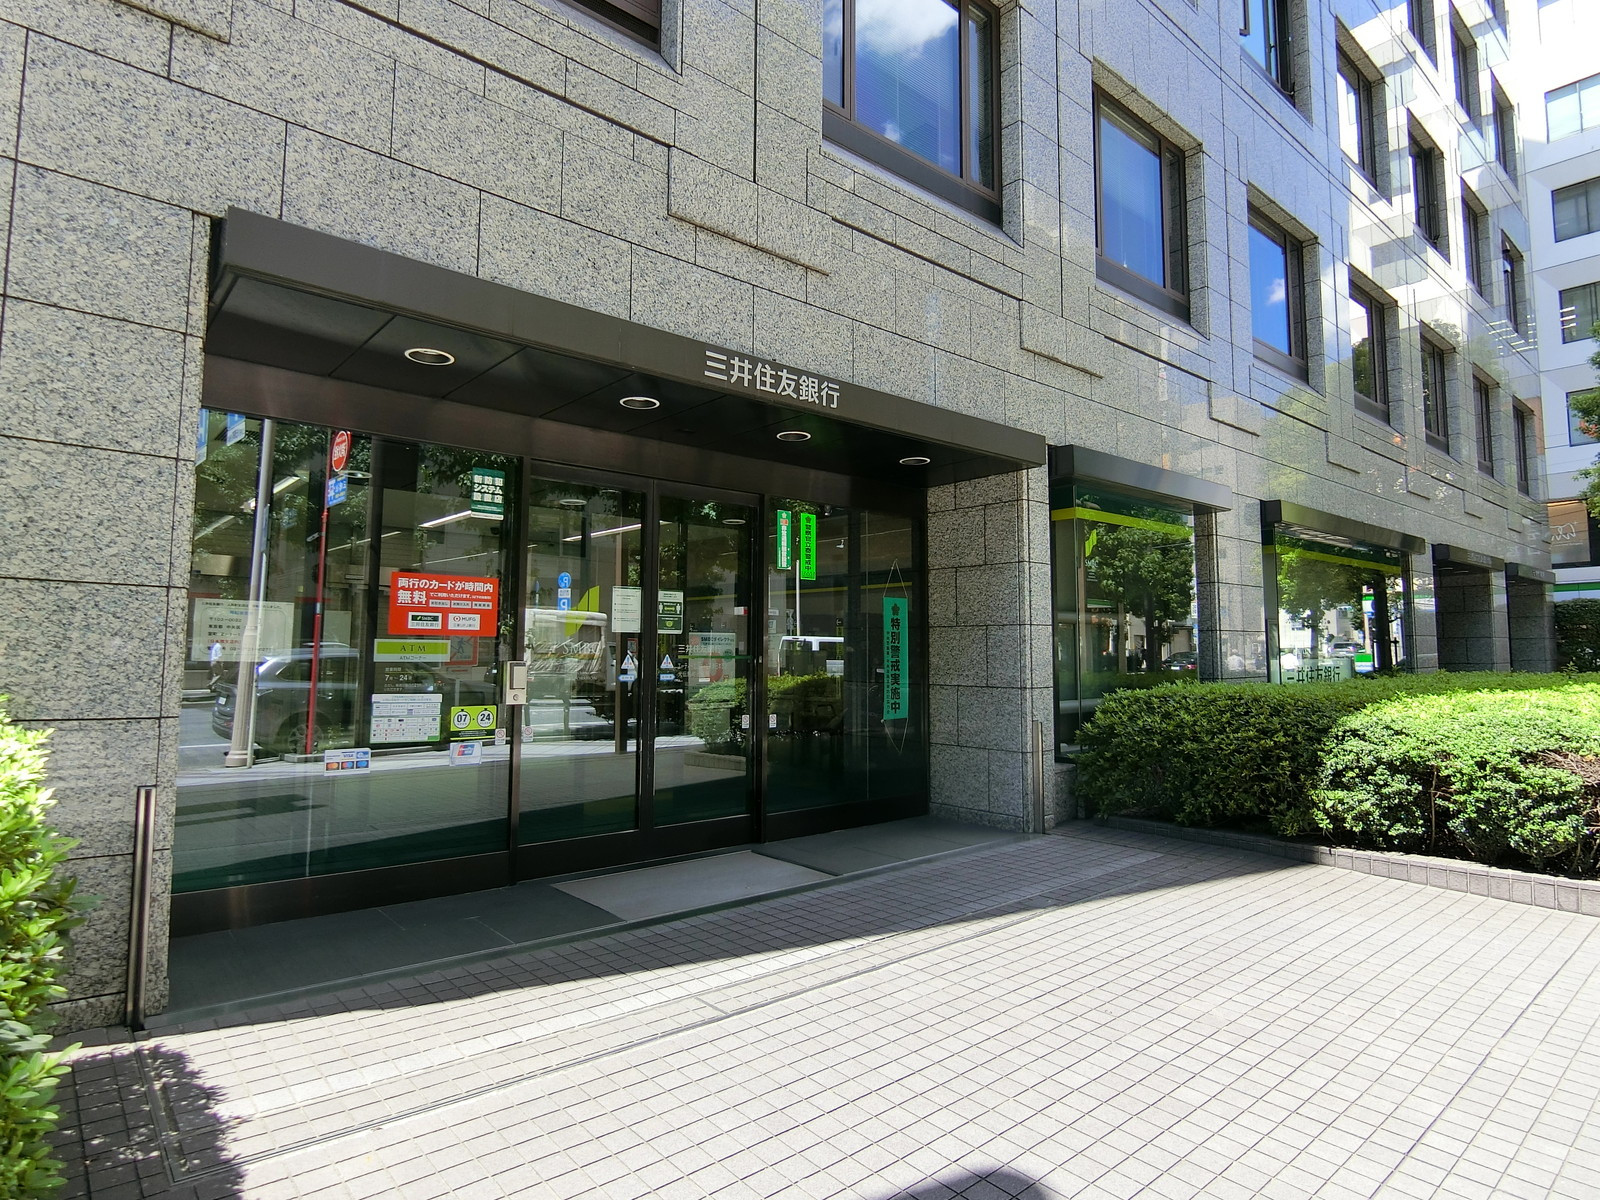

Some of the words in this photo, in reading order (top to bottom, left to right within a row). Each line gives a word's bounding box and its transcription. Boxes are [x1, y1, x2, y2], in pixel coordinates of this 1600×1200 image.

[704, 350, 841, 409] 三井住友銀行
[473, 483, 503, 494] システム
[398, 577, 494, 592] 両行のカードが時間内
[397, 590, 427, 604] 無料
[890, 617, 901, 714] 特別警戒実施中
[456, 714, 468, 723] 07
[480, 713, 491, 722] 24
